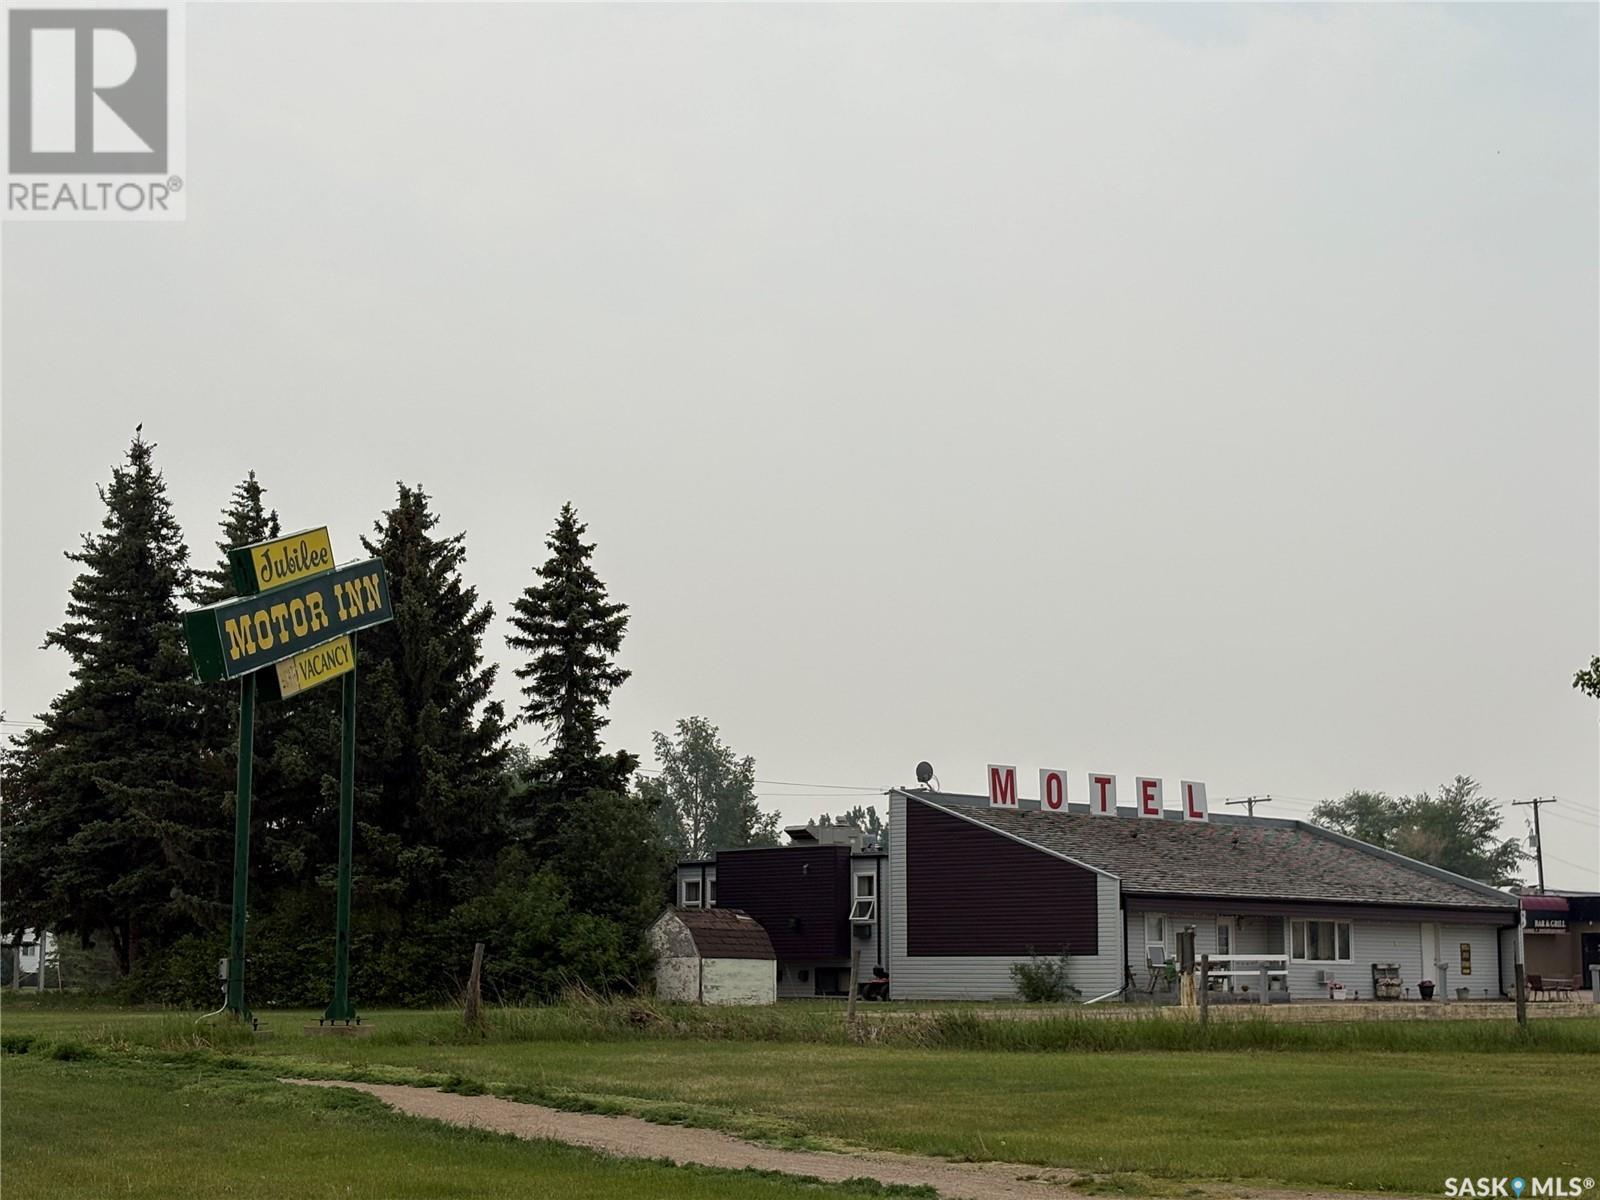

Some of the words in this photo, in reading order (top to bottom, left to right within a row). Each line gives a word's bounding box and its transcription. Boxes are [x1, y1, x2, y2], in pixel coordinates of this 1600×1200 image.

[260, 540, 328, 583] Jubilee
[225, 591, 329, 661] MOTOR
[334, 573, 382, 621] INN
[299, 644, 348, 680] VACANCY
[991, 767, 1204, 819] MOTEL
